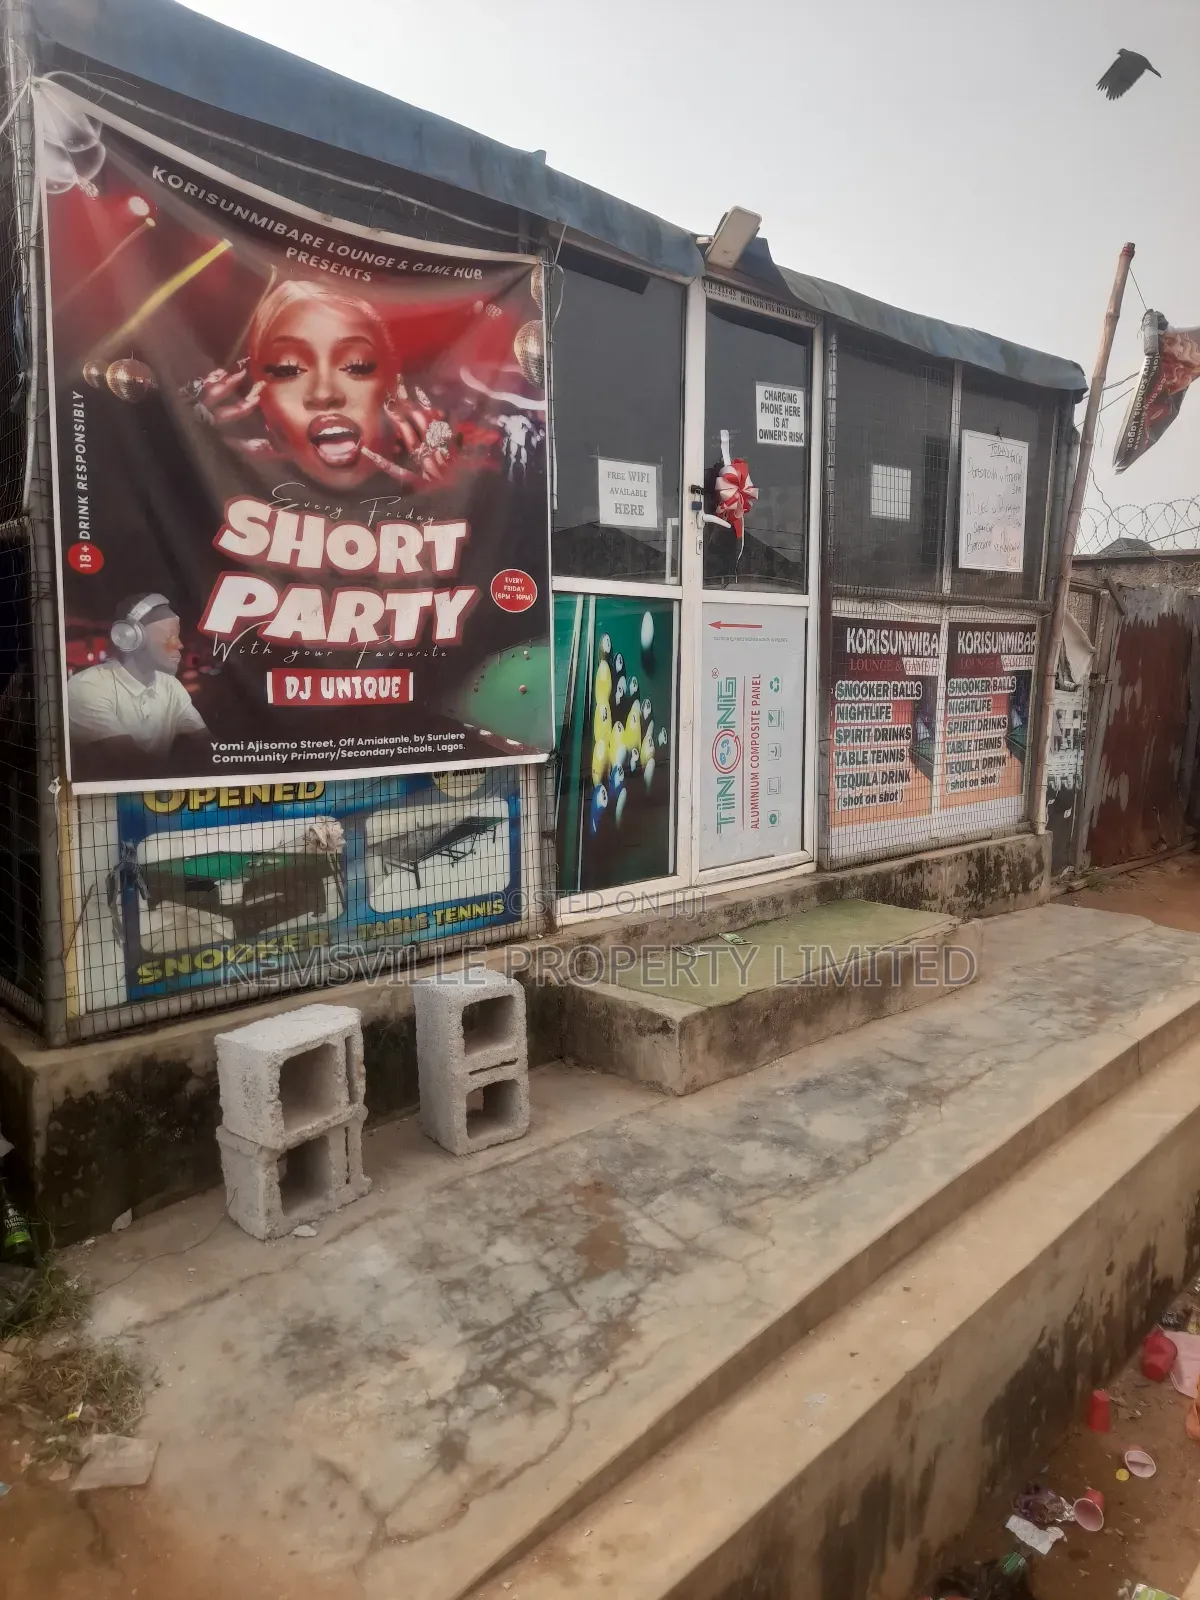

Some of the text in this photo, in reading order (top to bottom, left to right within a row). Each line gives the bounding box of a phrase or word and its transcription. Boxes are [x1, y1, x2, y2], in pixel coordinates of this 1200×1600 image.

[152, 165, 483, 280] KORISUNMIBARE LOUNGE & GAME HUB
[286, 246, 373, 282] PRESENTS
[764, 389, 798, 404] CHARGING
[760, 401, 801, 417] PHONE HERE
[773, 416, 790, 429] IS AT
[758, 428, 804, 443] OWNER'S RISK
[73, 390, 91, 540] DRINK RESPONSIBLY
[607, 470, 650, 483] FREE WIFI
[609, 487, 648, 498] AVAILABLE
[266, 482, 435, 526] Every Friday
[614, 502, 645, 516] HERE
[215, 497, 468, 575] SHORT
[80, 545, 92, 568] 18+
[202, 574, 476, 644] PARTY
[212, 621, 447, 668] With your Favourite
[850, 658, 892, 671] LOUNGE
[904, 660, 930, 673] GAME
[285, 676, 401, 700] DJ UNIQUE
[837, 682, 922, 700] SNOOKER BALLS
[948, 678, 1016, 694] SNOOKER BALLS
[837, 704, 892, 721] NIGHTLIFE
[948, 698, 992, 715] NIGHTLIFE
[835, 726, 912, 744] SPIRIT DRINKS
[947, 716, 1007, 735] SPIRIT DRINKS
[211, 741, 244, 752] Yomi
[247, 740, 298, 753] Ajisomo
[300, 739, 336, 750] Street,
[339, 737, 355, 747] Off
[414, 733, 425, 743] by
[427, 731, 466, 741] Surulere
[750, 674, 762, 829] ALUMINIUM COMPOSITE PANEL
[946, 736, 1002, 755] TABLE TENNIS
[212, 742, 466, 764] Community Primary/Secondary Schools, Lagos.
[834, 748, 906, 767] TABLE TENNIS
[945, 755, 1007, 775] TEQUILA DRINK
[835, 769, 911, 790] TEQUILA DRINK
[969, 777, 979, 787] on
[143, 781, 326, 813] OPENED
[865, 794, 877, 805] on
[358, 898, 504, 941] TABLE TENNIS
